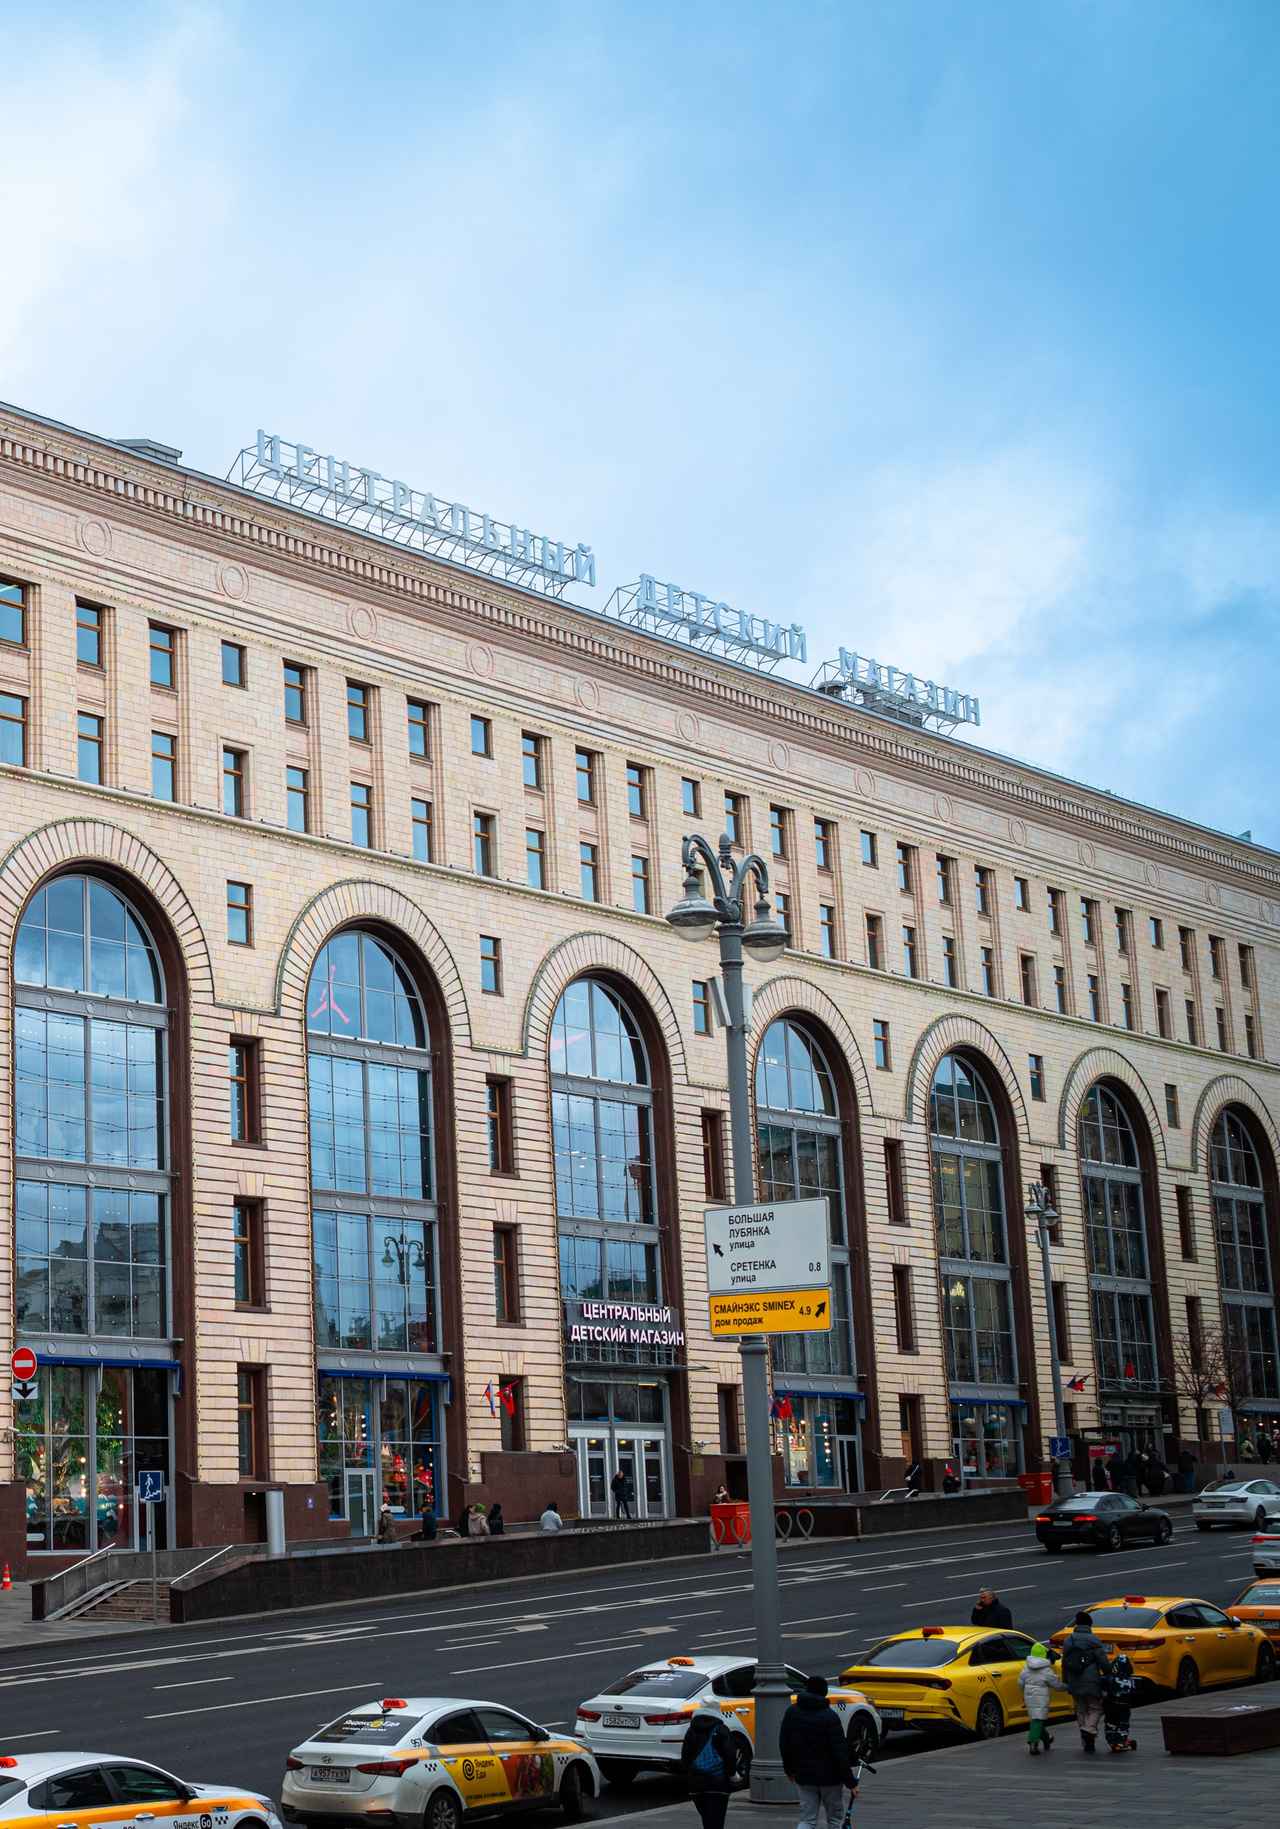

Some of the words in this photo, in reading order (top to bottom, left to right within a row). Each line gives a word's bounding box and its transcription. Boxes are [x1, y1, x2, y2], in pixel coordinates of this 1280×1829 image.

[256, 429, 596, 588] ЦЕНТРАЛЬНЫЙ
[636, 573, 808, 664] ДЕТСКИЙ
[838, 646, 982, 727] МАГАЗИН
[728, 1211, 775, 1225] БОЛЬШАЯ
[728, 1226, 771, 1239] ЛУБЯНКА
[729, 1240, 755, 1252] улица
[730, 1260, 777, 1273] СРЕТЕНКА
[808, 1261, 822, 1273] 0.8
[730, 1274, 756, 1286] улица
[582, 1303, 671, 1324] ЦЕНТРАЛЬНЫЙ
[713, 1302, 761, 1315] СМАЙНЭКС
[762, 1300, 796, 1312] SMINEX
[798, 1305, 812, 1316] 4.9
[714, 1319, 731, 1329] дом
[732, 1316, 764, 1329] продаж
[571, 1324, 627, 1343] ДЕТСКИЙ
[629, 1328, 685, 1346] МАГАЗИН
[410, 1737, 423, 1748] 957
[474, 1758, 495, 1769] Яндекс
[475, 1769, 487, 1780] Еда
[173, 1819, 199, 1829] Яндекс
[201, 1816, 212, 1828] Go
